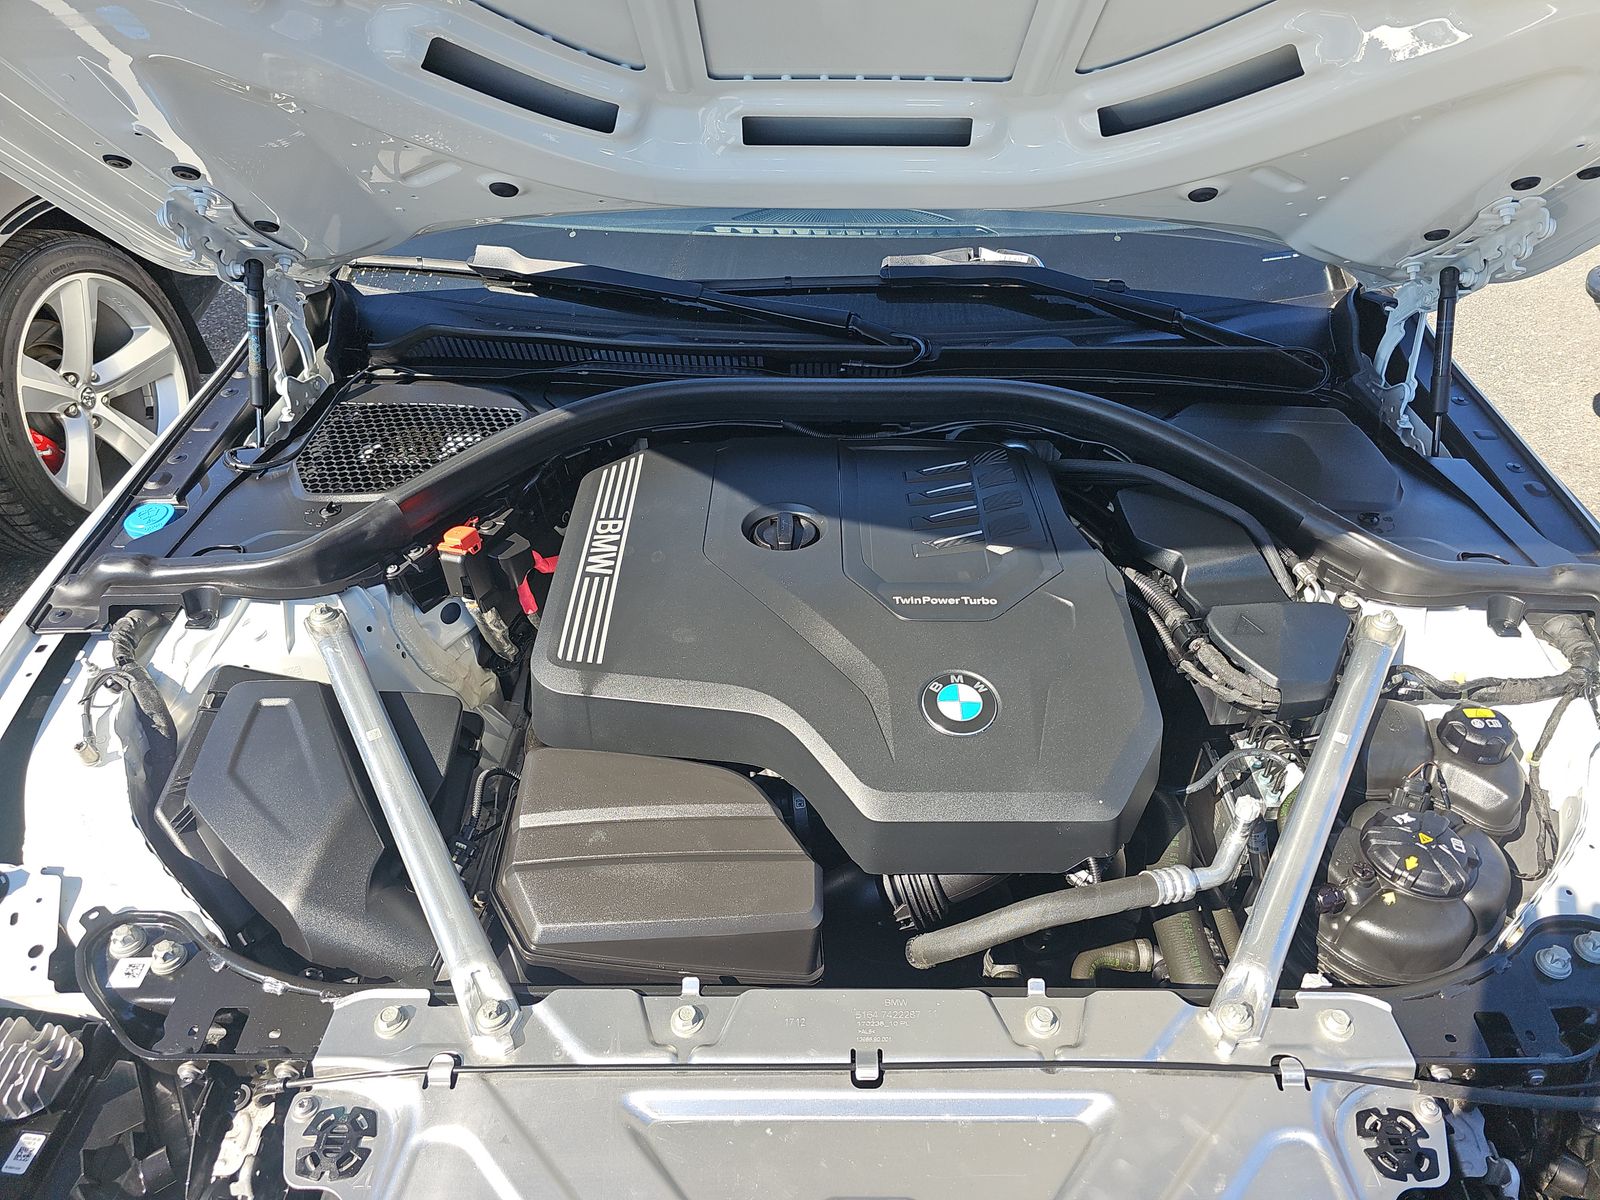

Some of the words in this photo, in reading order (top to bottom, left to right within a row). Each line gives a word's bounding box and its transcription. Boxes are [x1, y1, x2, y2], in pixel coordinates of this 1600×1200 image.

[585, 519, 624, 575] BMW
[892, 595, 960, 605] TwinPower
[961, 595, 998, 605] Turbo
[929, 674, 988, 693] BMW
[884, 998, 908, 1007] BMW
